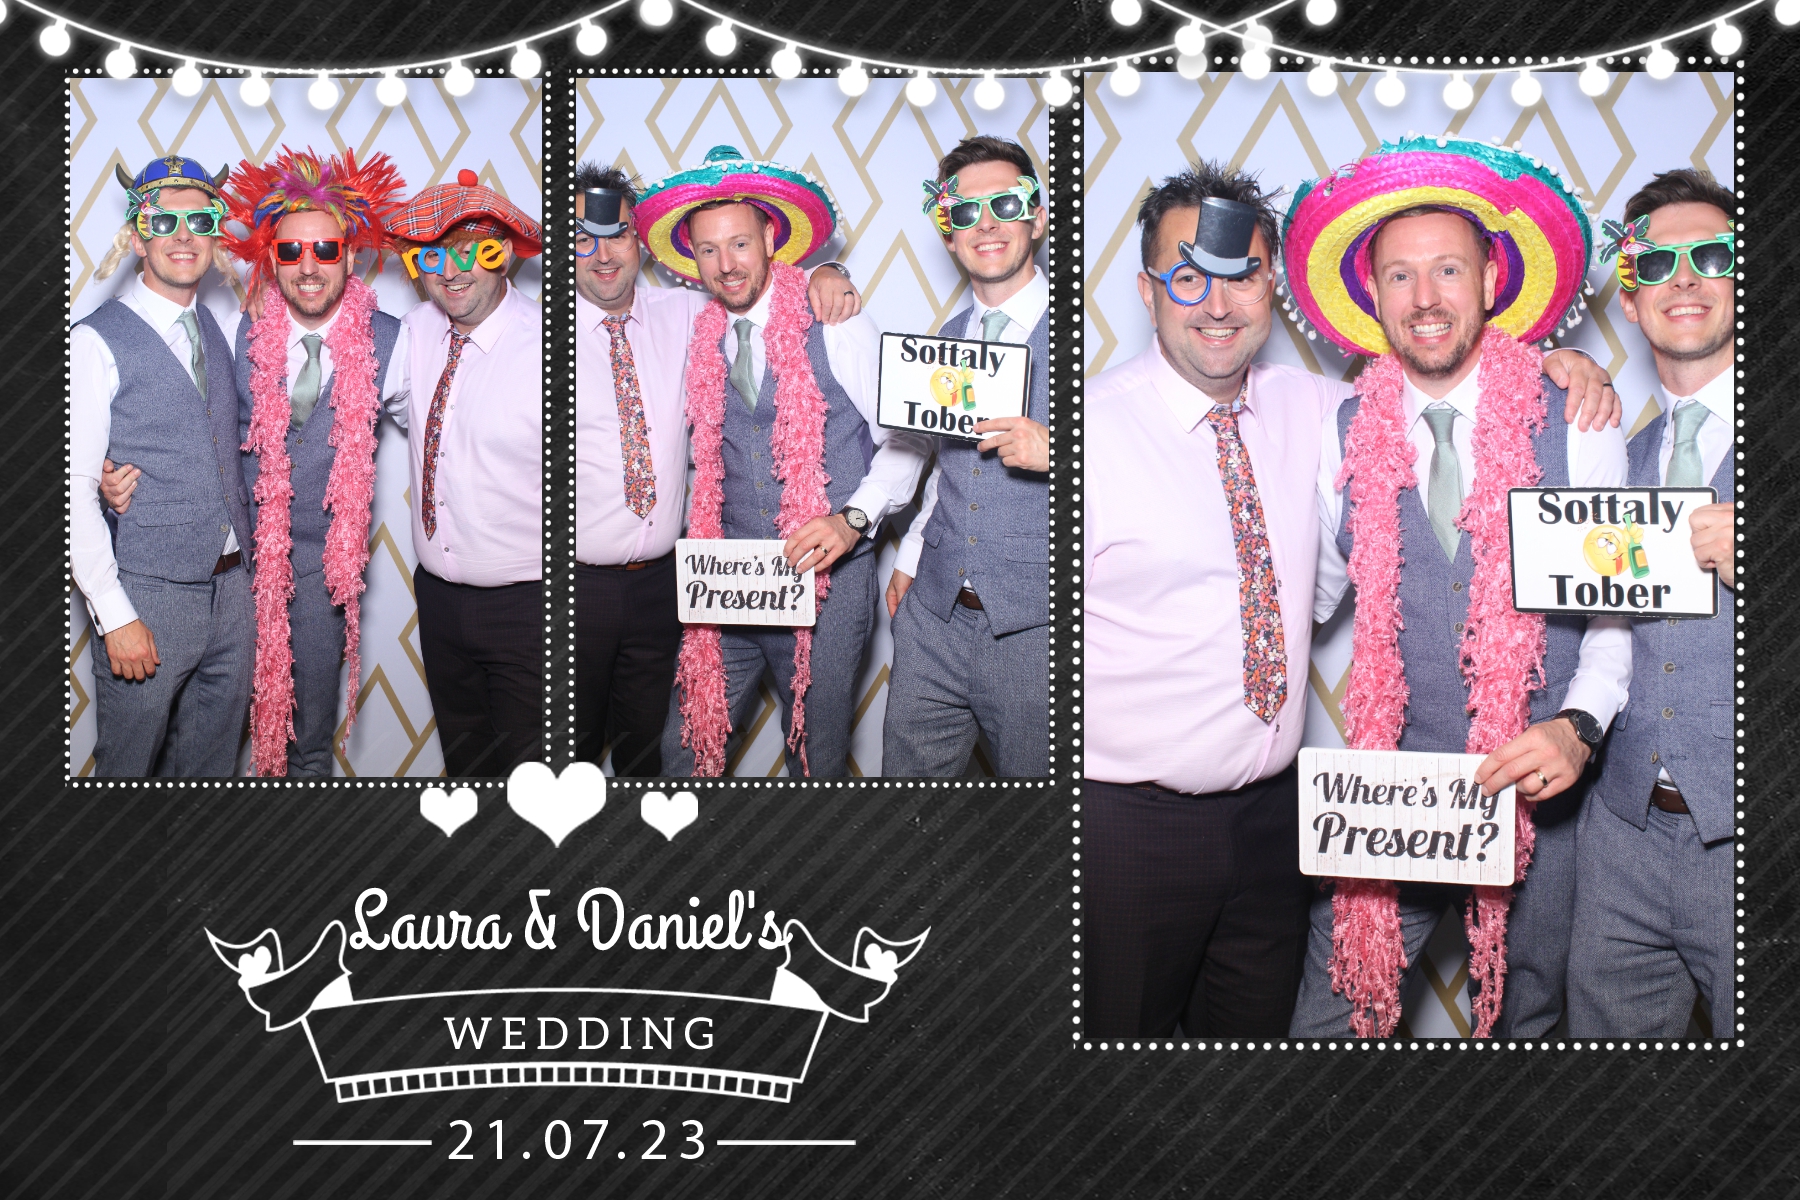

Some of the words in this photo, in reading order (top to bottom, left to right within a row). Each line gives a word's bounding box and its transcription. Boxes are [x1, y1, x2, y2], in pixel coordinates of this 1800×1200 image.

[402, 239, 505, 279] rave
[900, 336, 1006, 378] Sottaly
[1538, 489, 1684, 533] Sottaly
[684, 554, 765, 576] Where's
[685, 580, 805, 611] Present?
[1549, 574, 1671, 609] Tober
[1312, 771, 1438, 808] Where's
[1448, 778, 1500, 820] My
[1312, 811, 1500, 862] Present?
